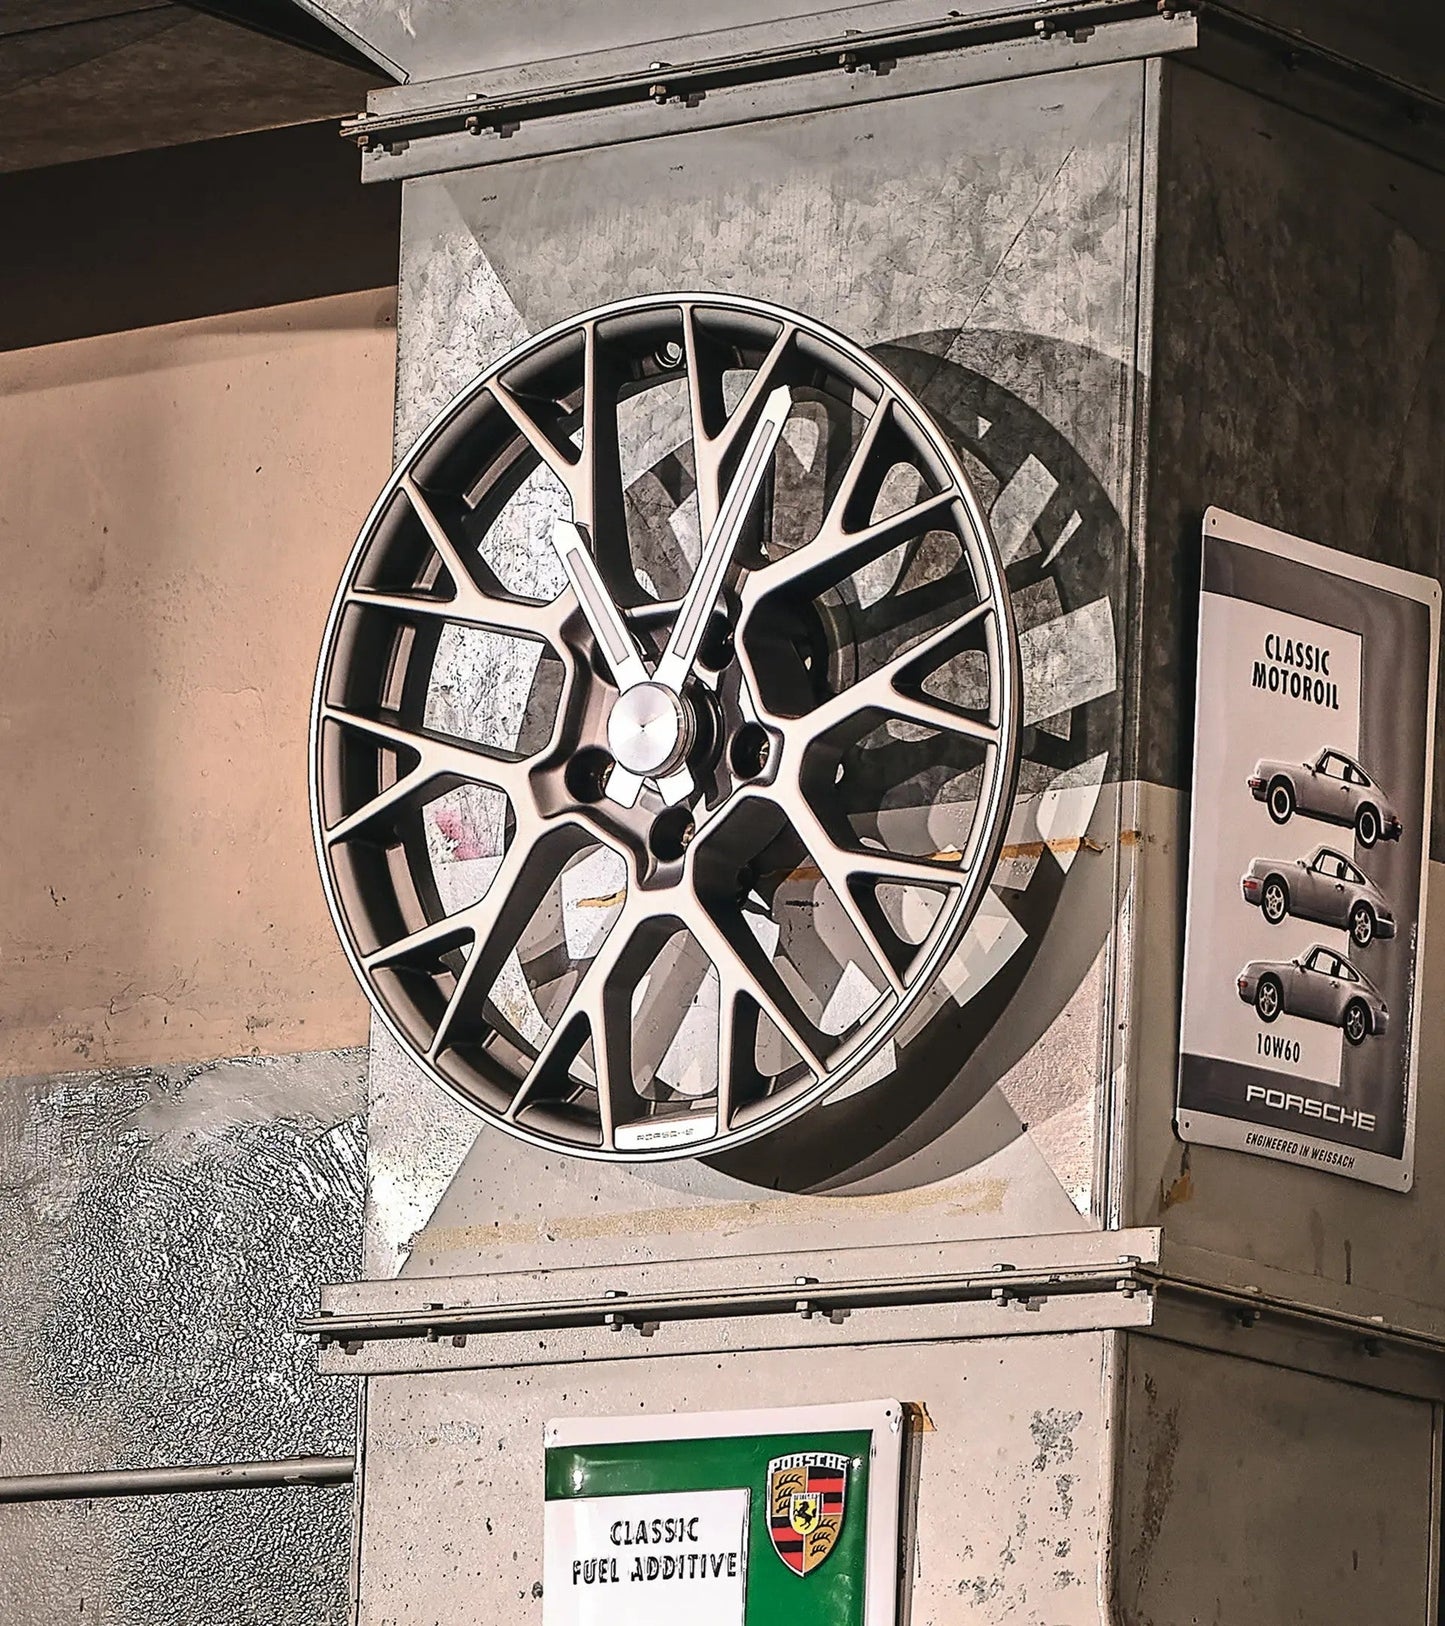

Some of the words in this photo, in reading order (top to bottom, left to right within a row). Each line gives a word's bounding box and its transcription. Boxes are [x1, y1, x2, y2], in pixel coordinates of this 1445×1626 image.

[1265, 634, 1330, 676] CLASSIC
[1252, 661, 1339, 710] MOTOROIL
[1257, 1033, 1301, 1063] 10W60
[1246, 1085, 1376, 1131] PORSCHE
[636, 1128, 694, 1141] PORSCE
[1246, 1132, 1298, 1155] ENGINEERED
[1299, 1145, 1309, 1157] IN
[1311, 1147, 1355, 1169] WEISSACH
[773, 1454, 847, 1472] PORSCHE
[610, 1517, 699, 1546] CLASSIC
[572, 1558, 620, 1585] FUEL
[630, 1552, 737, 1581] ADDITIVE
